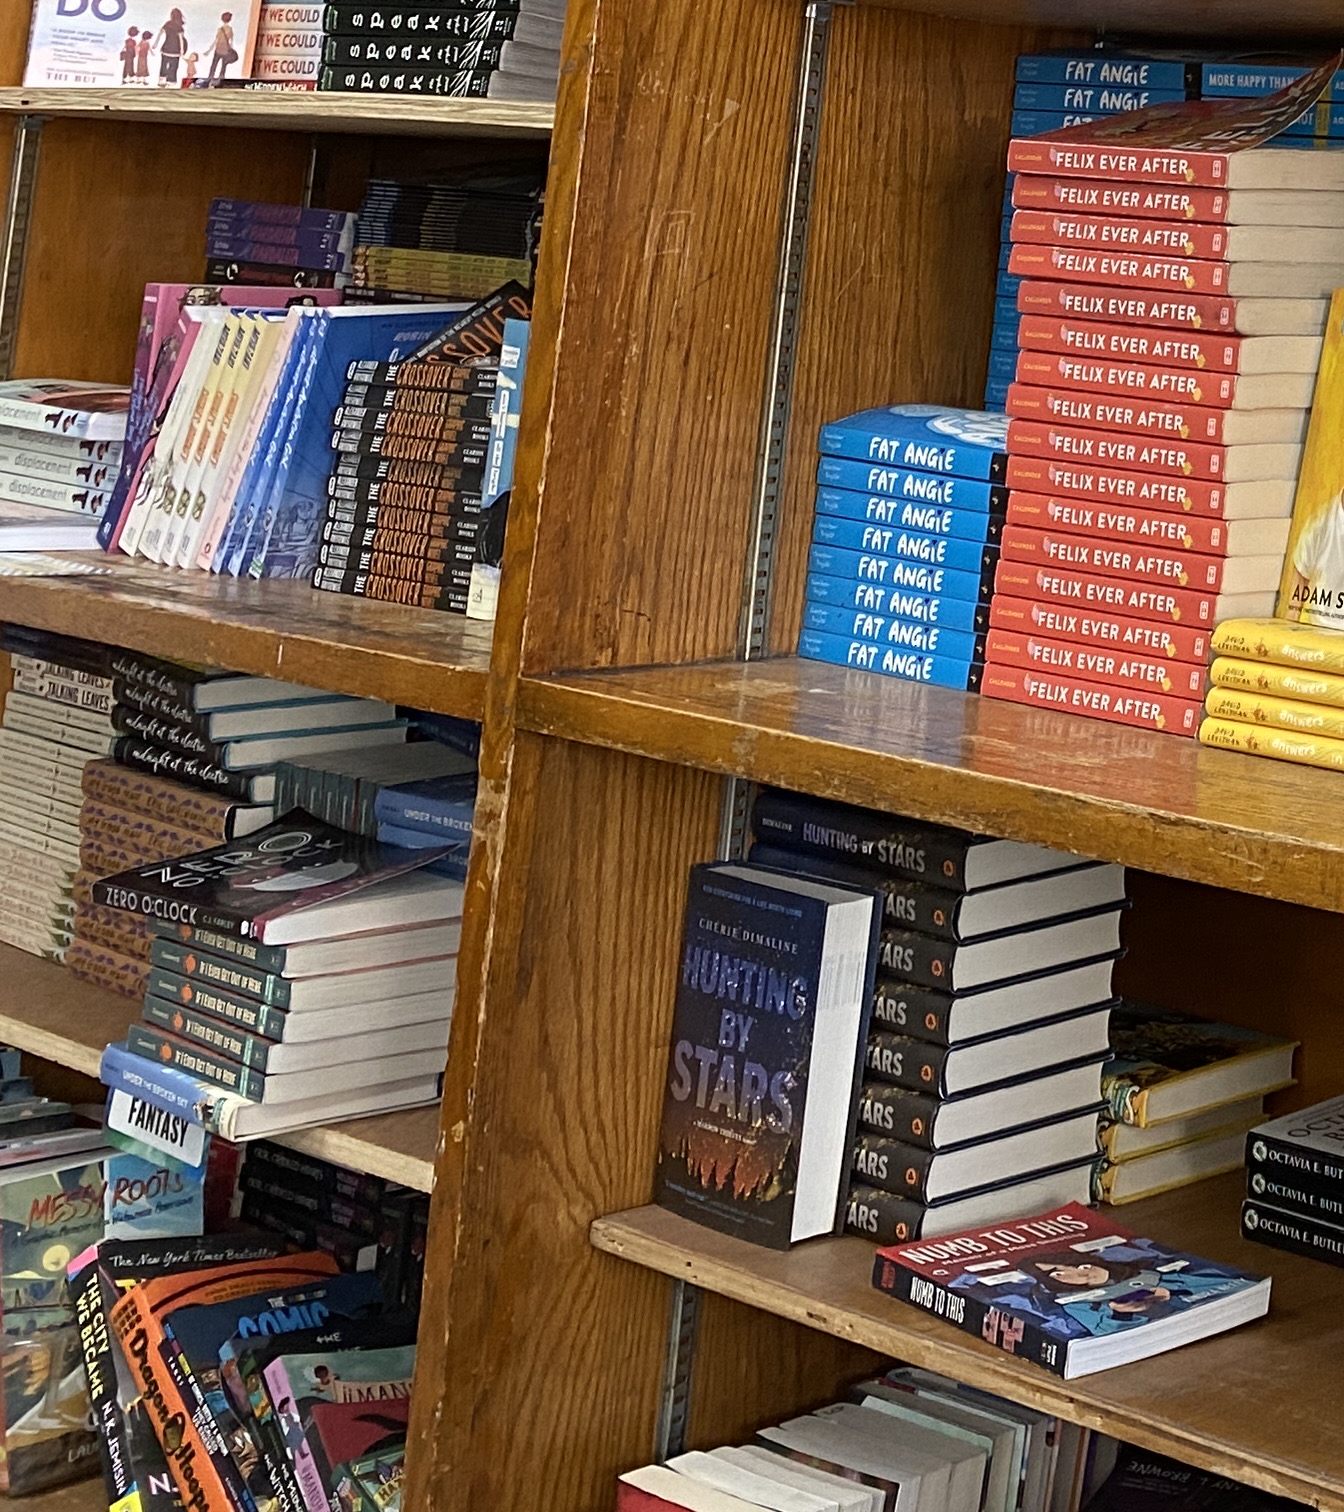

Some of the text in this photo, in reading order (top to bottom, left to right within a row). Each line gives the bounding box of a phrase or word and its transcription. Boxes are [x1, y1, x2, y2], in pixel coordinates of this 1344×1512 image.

[1065, 61, 1094, 81] FAT
[1055, 151, 1188, 175] FELIX EVER AFTER
[385, 363, 450, 388] THE CROSSOVER
[1292, 585, 1333, 608] ADAM
[105, 887, 137, 911] ZERO
[127, 1098, 189, 1148] FANTASY
[899, 1214, 1089, 1265] NUMB TO THIS
